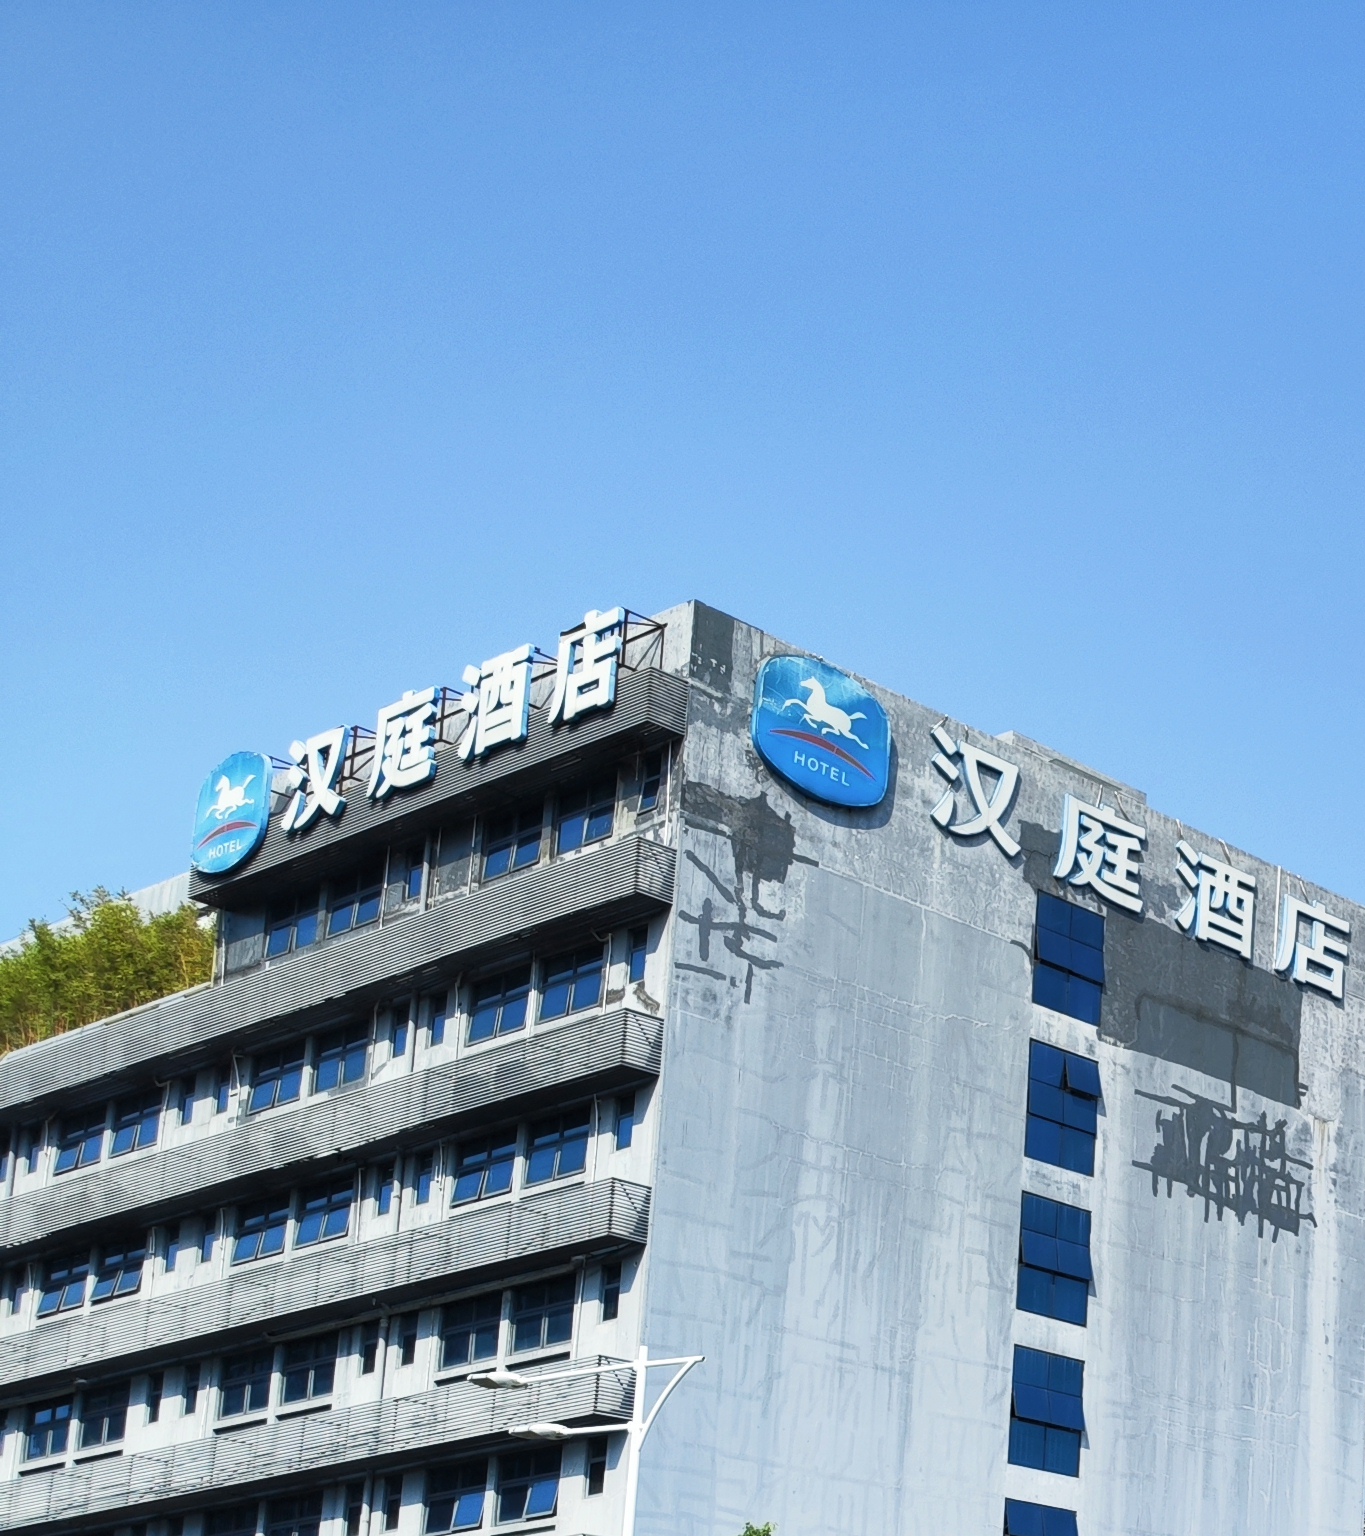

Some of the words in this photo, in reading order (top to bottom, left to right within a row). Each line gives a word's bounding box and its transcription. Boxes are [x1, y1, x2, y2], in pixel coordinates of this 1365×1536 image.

[281, 607, 626, 834] 汉庭酒店
[794, 750, 851, 788] HOTEL
[208, 838, 243, 860] HOTEL
[931, 726, 1351, 1000] 汉庭酒店
